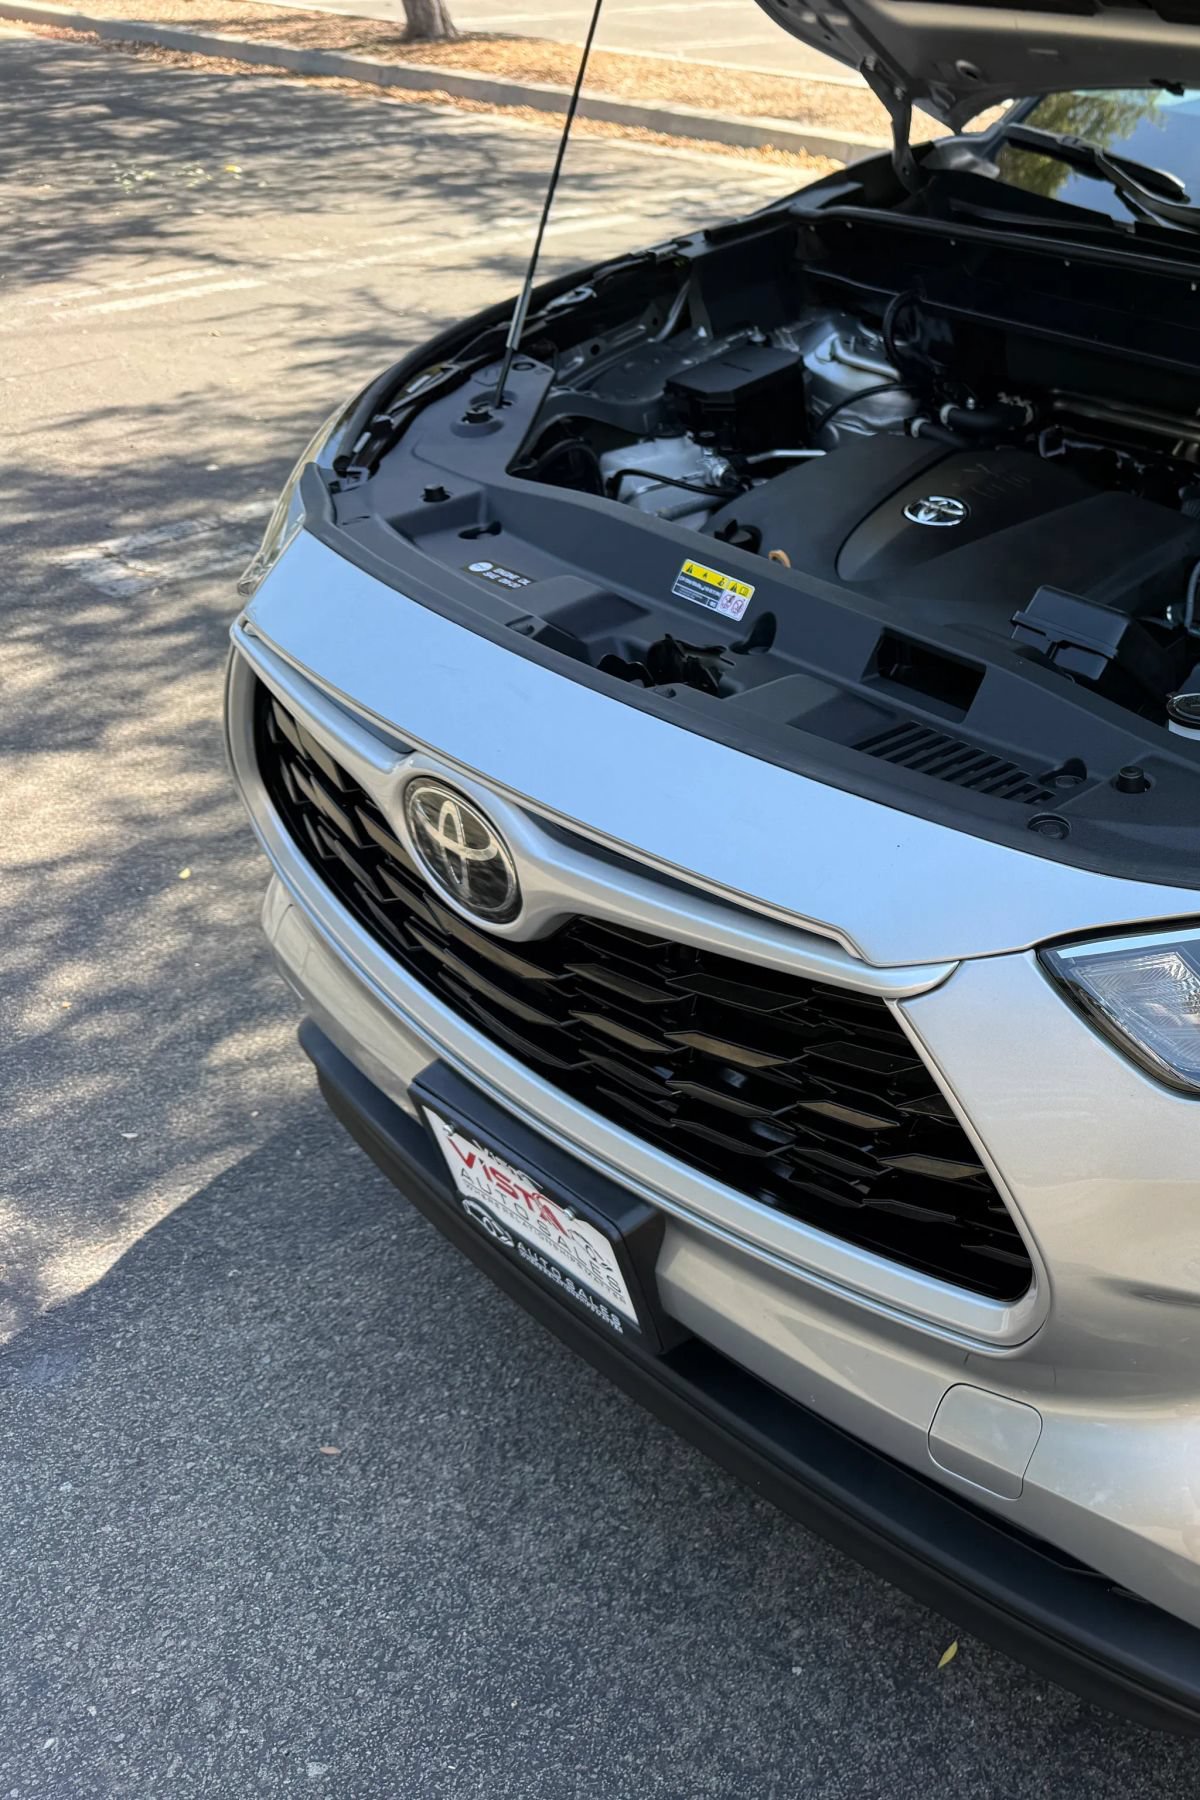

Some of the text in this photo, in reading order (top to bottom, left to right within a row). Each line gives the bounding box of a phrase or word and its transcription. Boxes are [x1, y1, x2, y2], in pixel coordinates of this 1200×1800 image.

[461, 1168, 529, 1220] AUTO
[536, 1219, 622, 1293] SALES
[517, 1242, 562, 1281] AUTO
[565, 1277, 622, 1330] SALES
